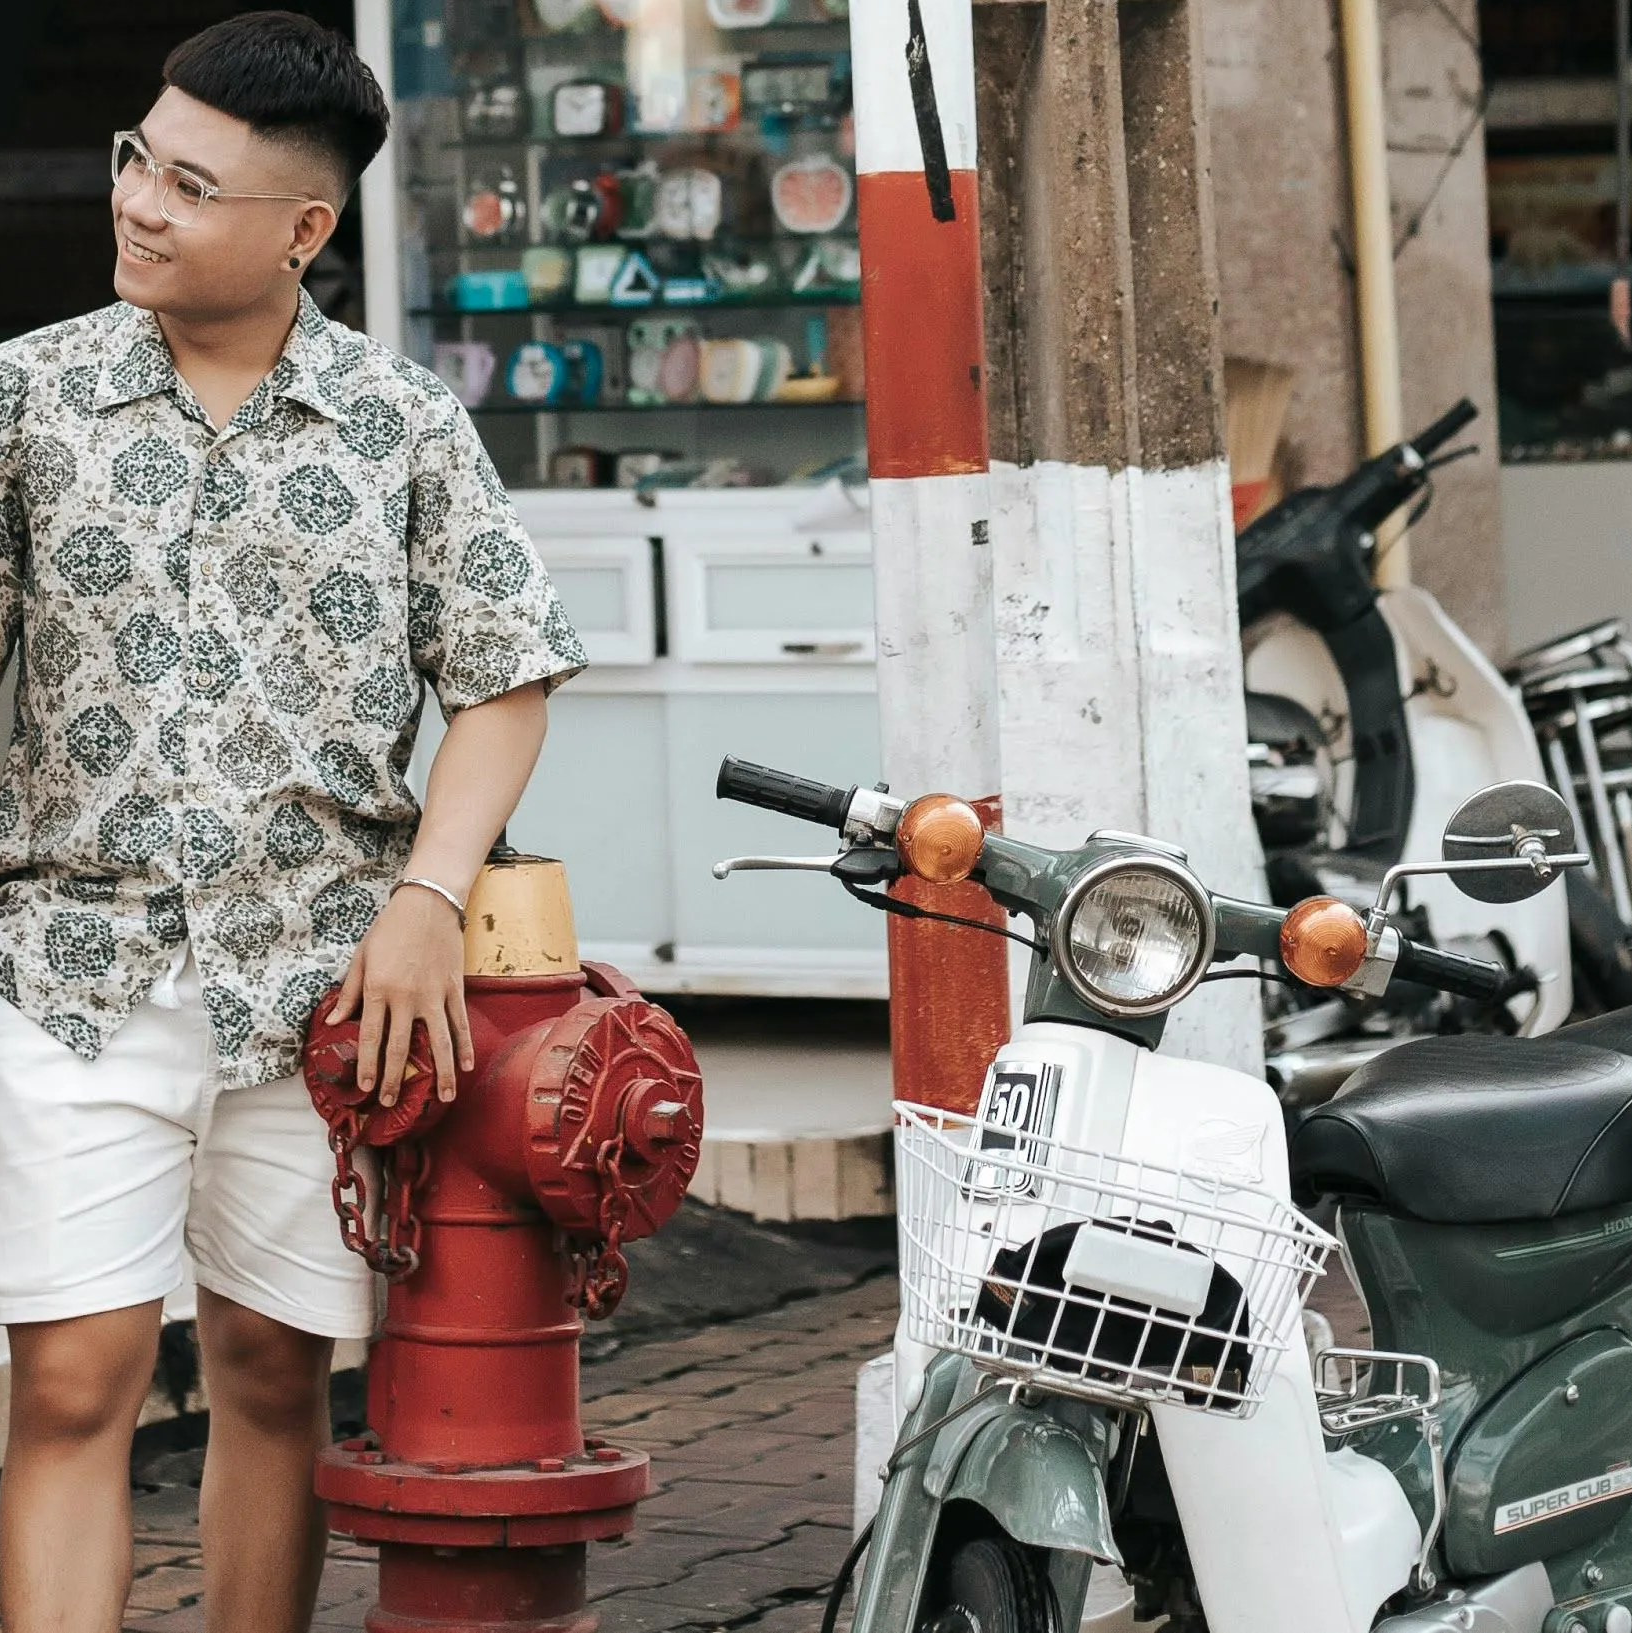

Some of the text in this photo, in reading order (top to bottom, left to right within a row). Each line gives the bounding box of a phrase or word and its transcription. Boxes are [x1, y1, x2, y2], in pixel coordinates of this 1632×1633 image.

[561, 1040, 603, 1121] OPEN
[990, 1082, 1031, 1130] 50
[1507, 1490, 1571, 1524] SUPER
[1576, 1478, 1612, 1502] CUB
